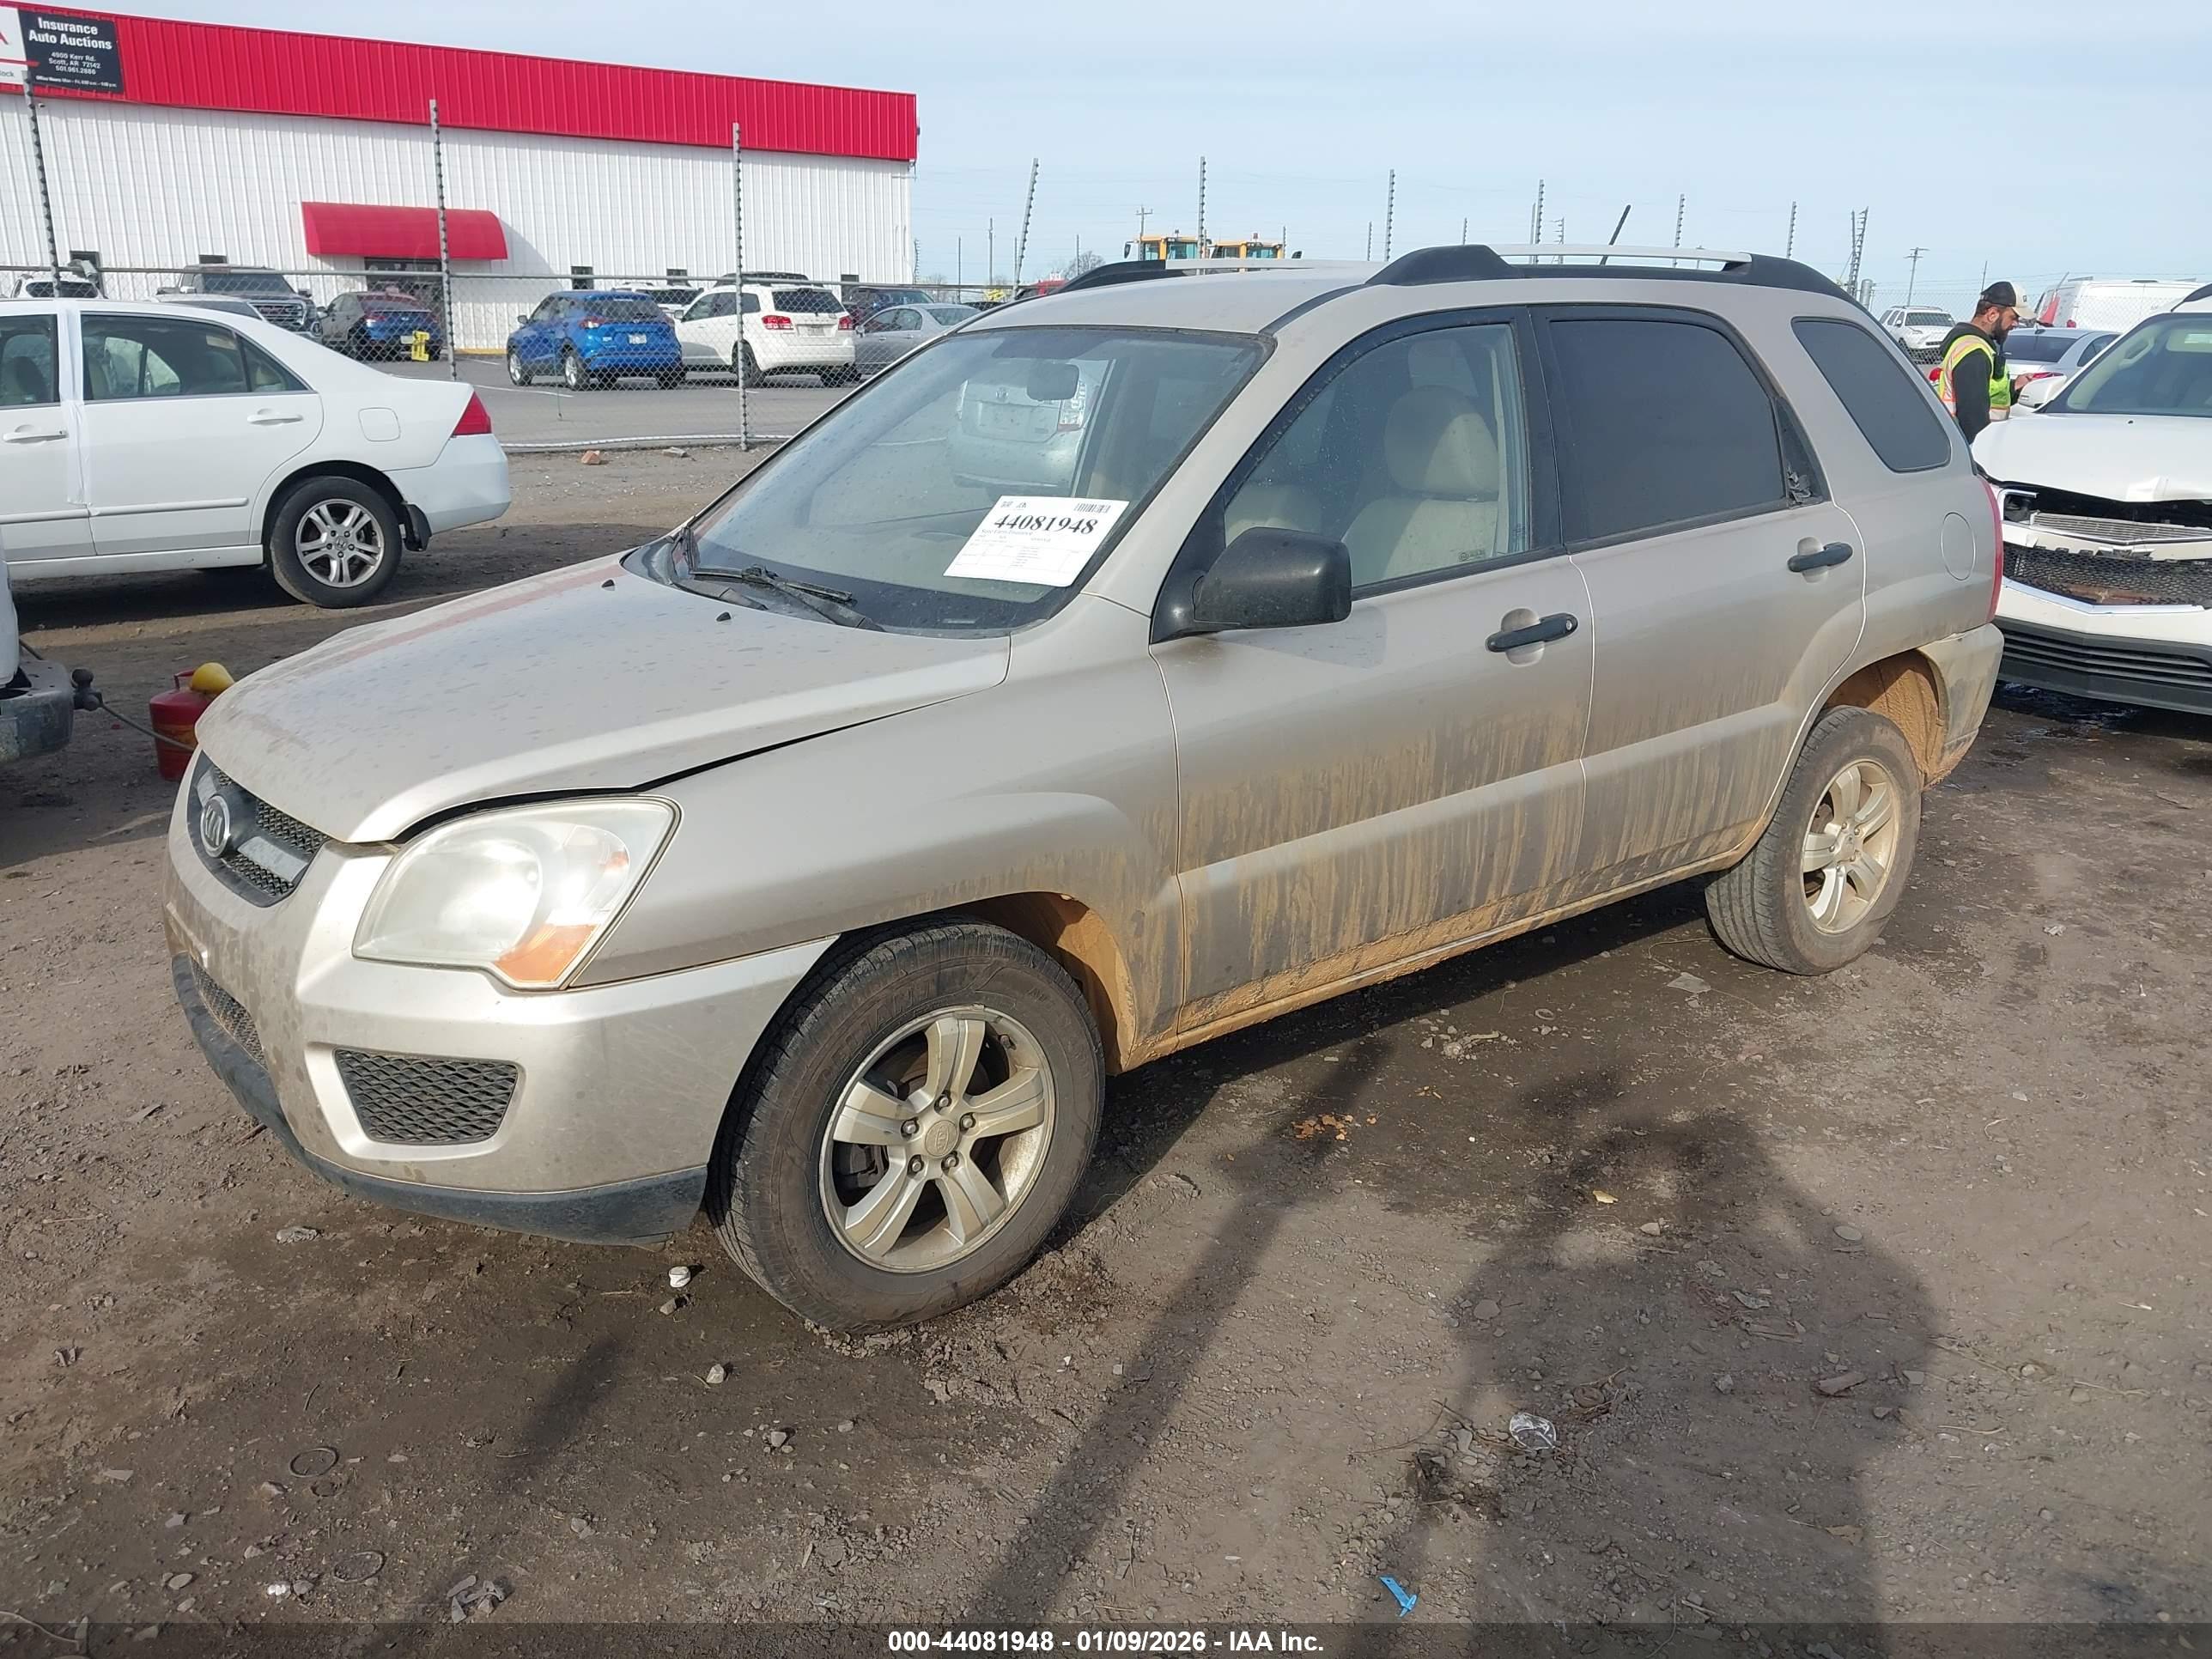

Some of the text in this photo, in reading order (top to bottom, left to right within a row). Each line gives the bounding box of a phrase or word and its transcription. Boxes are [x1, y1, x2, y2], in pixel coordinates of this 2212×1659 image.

[38, 17, 98, 35] Insurance
[29, 30, 112, 50] Auto Auctions
[994, 514, 1098, 535] 44081948
